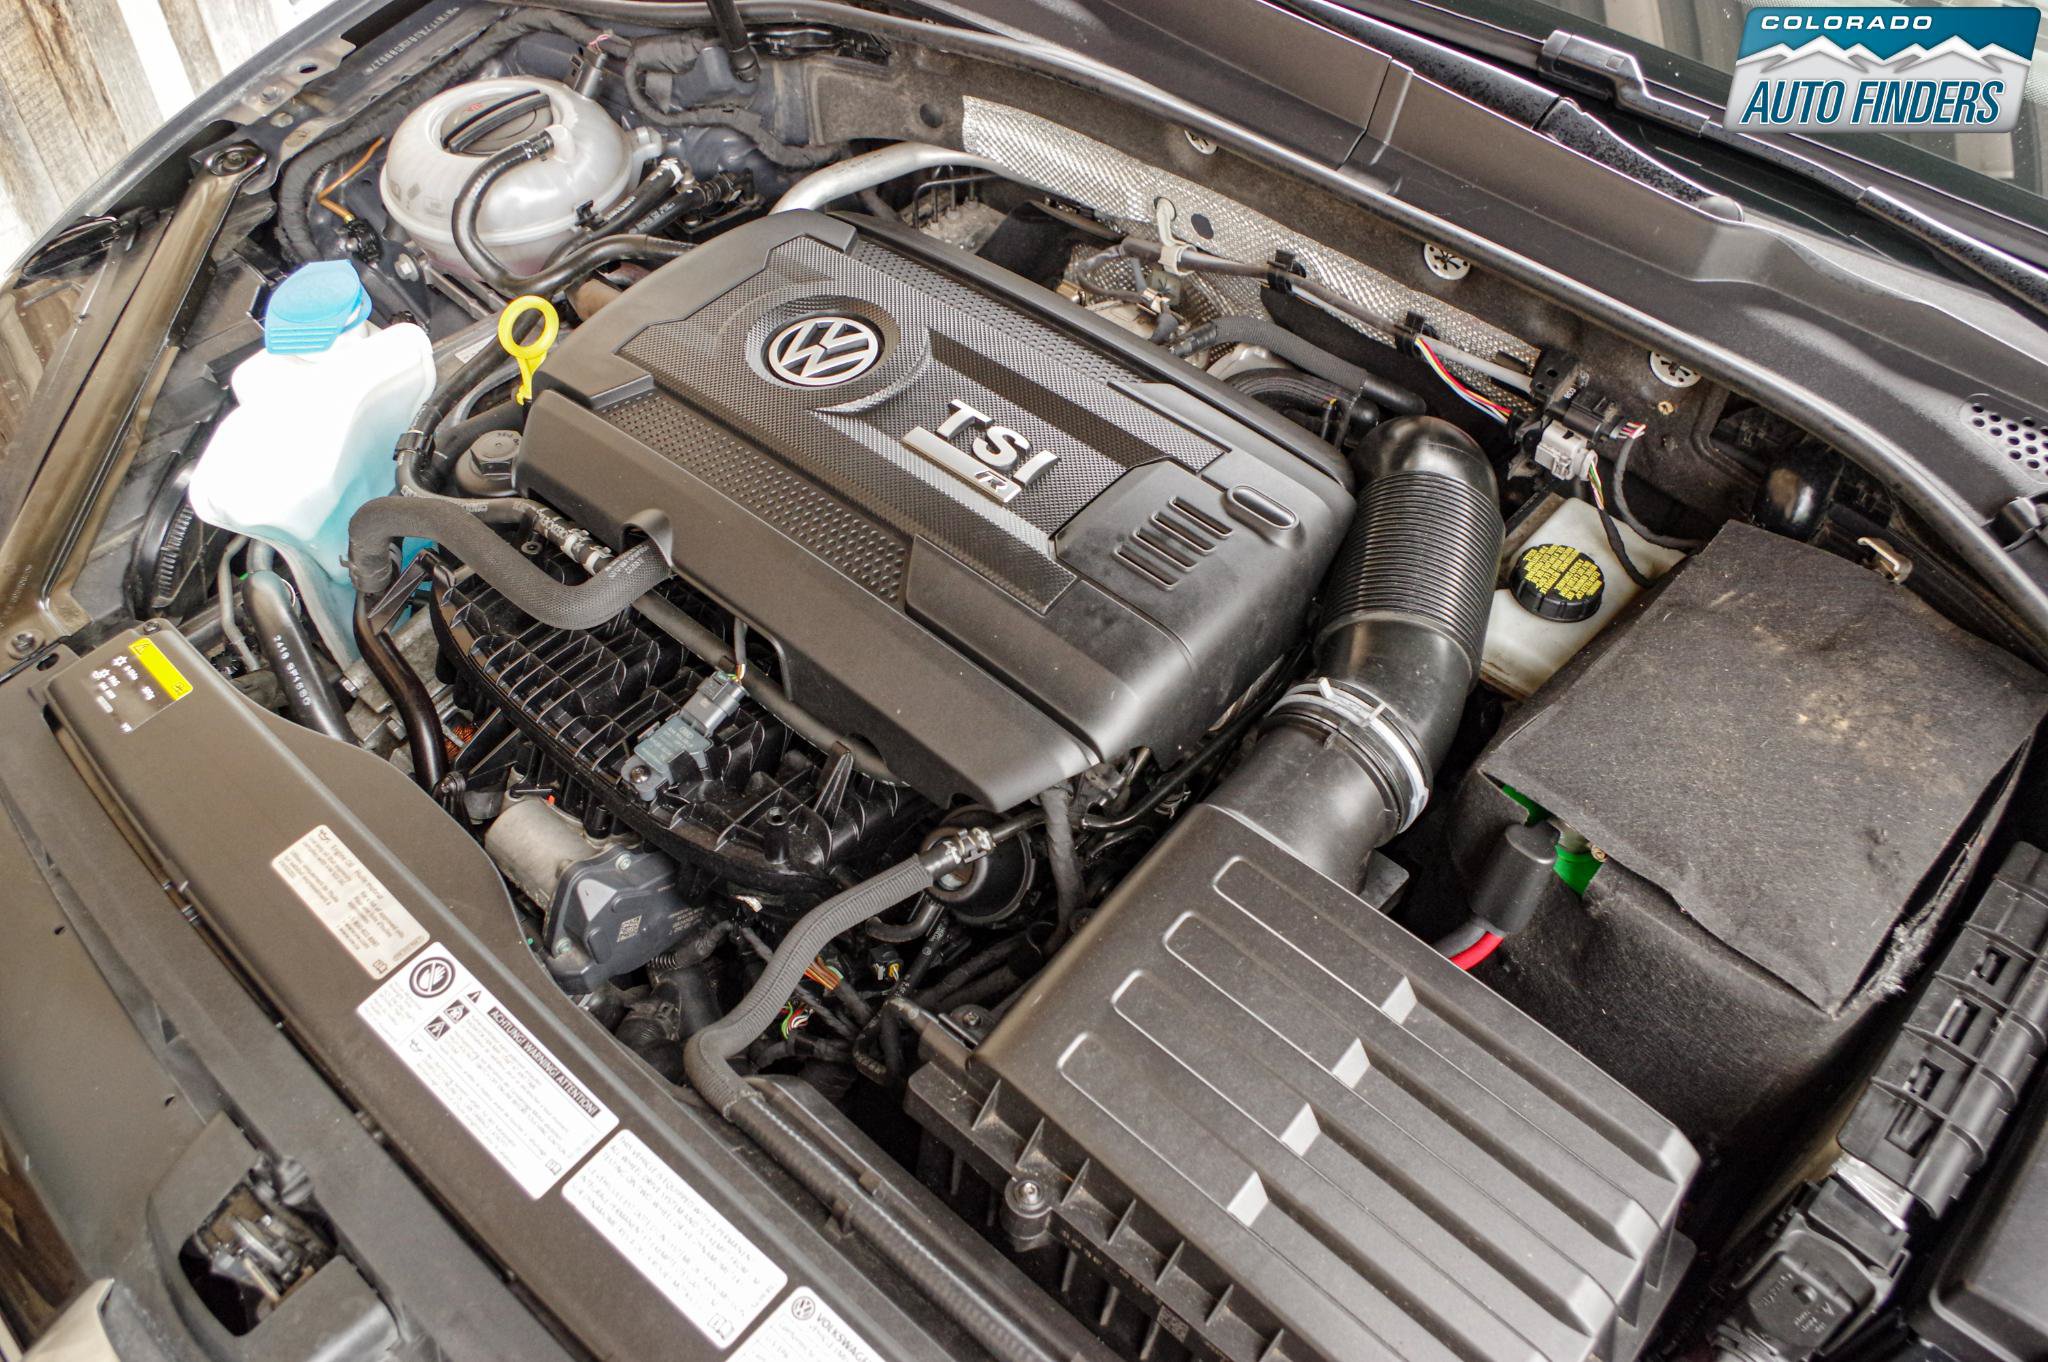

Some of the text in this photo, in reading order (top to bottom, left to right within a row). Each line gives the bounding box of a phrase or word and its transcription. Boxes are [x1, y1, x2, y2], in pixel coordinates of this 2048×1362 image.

[936, 399, 1059, 486] TSI
[488, 1008, 598, 1116] ACHTUNG! WARNING! ATTENTION!
